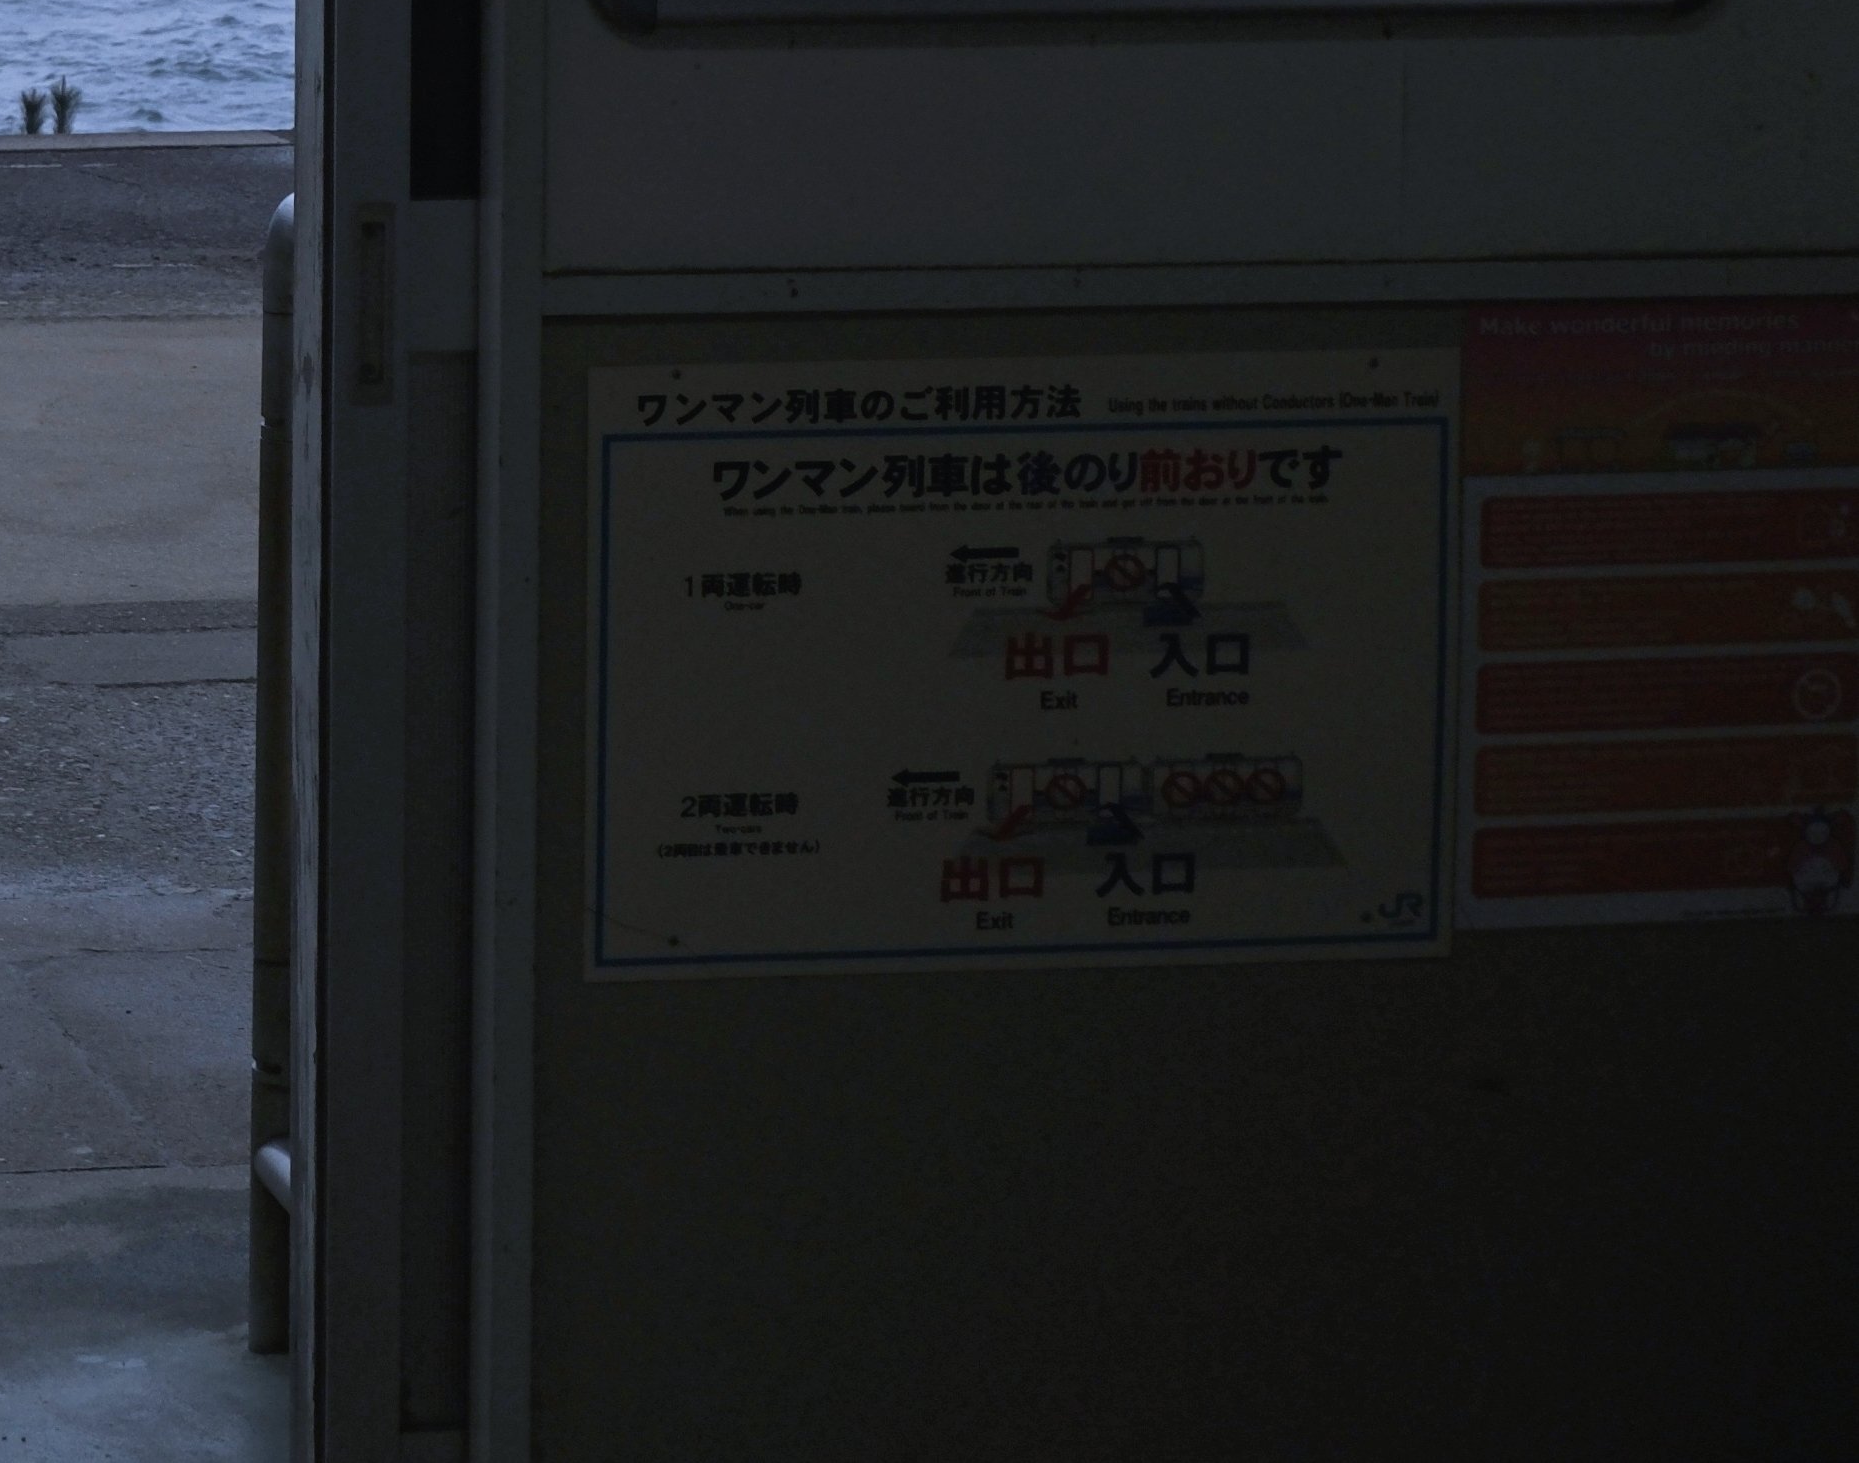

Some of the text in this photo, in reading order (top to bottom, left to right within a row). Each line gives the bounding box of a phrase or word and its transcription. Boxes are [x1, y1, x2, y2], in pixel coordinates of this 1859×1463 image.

[1479, 311, 1801, 337] Make wonderful memories
[1647, 339, 1774, 360] by minding
[637, 384, 1083, 428] ワンマン列車のご利用方法
[1107, 396, 1144, 416] Using
[1148, 397, 1168, 413] the
[1172, 395, 1208, 412] trains
[1212, 395, 1259, 412] without
[1262, 393, 1335, 411] Conductors
[712, 444, 1343, 500] ワンマン列車は後のり前おりです
[683, 572, 803, 600] 1両運転時
[945, 562, 1035, 585] 進行方向
[1003, 631, 1251, 682] 出口 入口
[1039, 687, 1250, 711] Exit Entrance
[680, 792, 800, 820] 2両運転時
[887, 786, 976, 810] 進行方向
[940, 851, 1197, 903] 出口 入口
[975, 907, 1191, 931] Exit Entrance
[1377, 892, 1425, 920] JR
